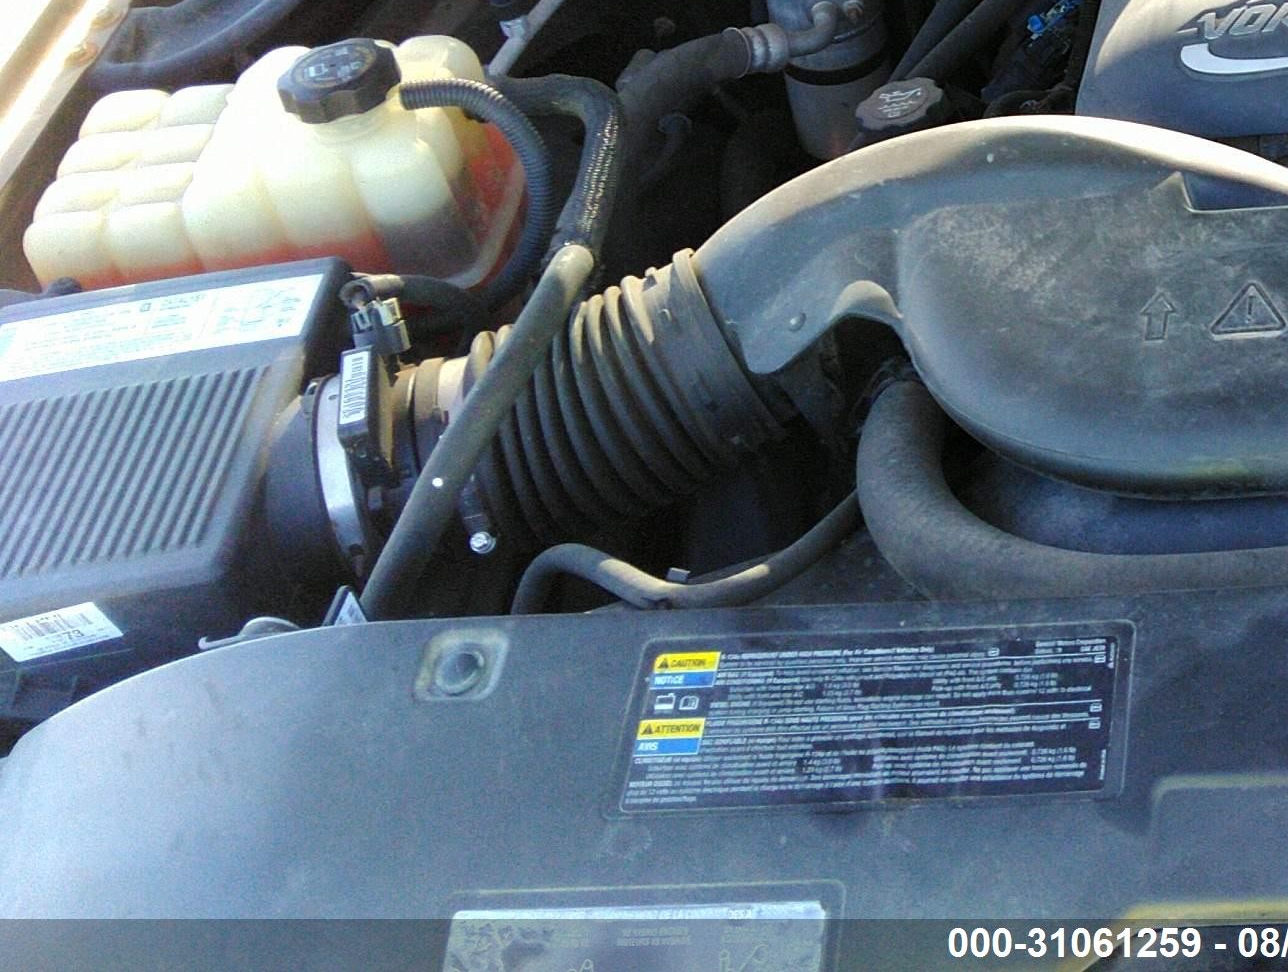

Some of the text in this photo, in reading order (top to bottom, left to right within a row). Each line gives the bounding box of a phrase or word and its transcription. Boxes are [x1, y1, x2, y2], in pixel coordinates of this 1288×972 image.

[670, 658, 707, 668] CAUTION
[654, 674, 685, 685] NOTICE
[655, 723, 701, 734] ATTENTION
[637, 741, 659, 751] AVIS
